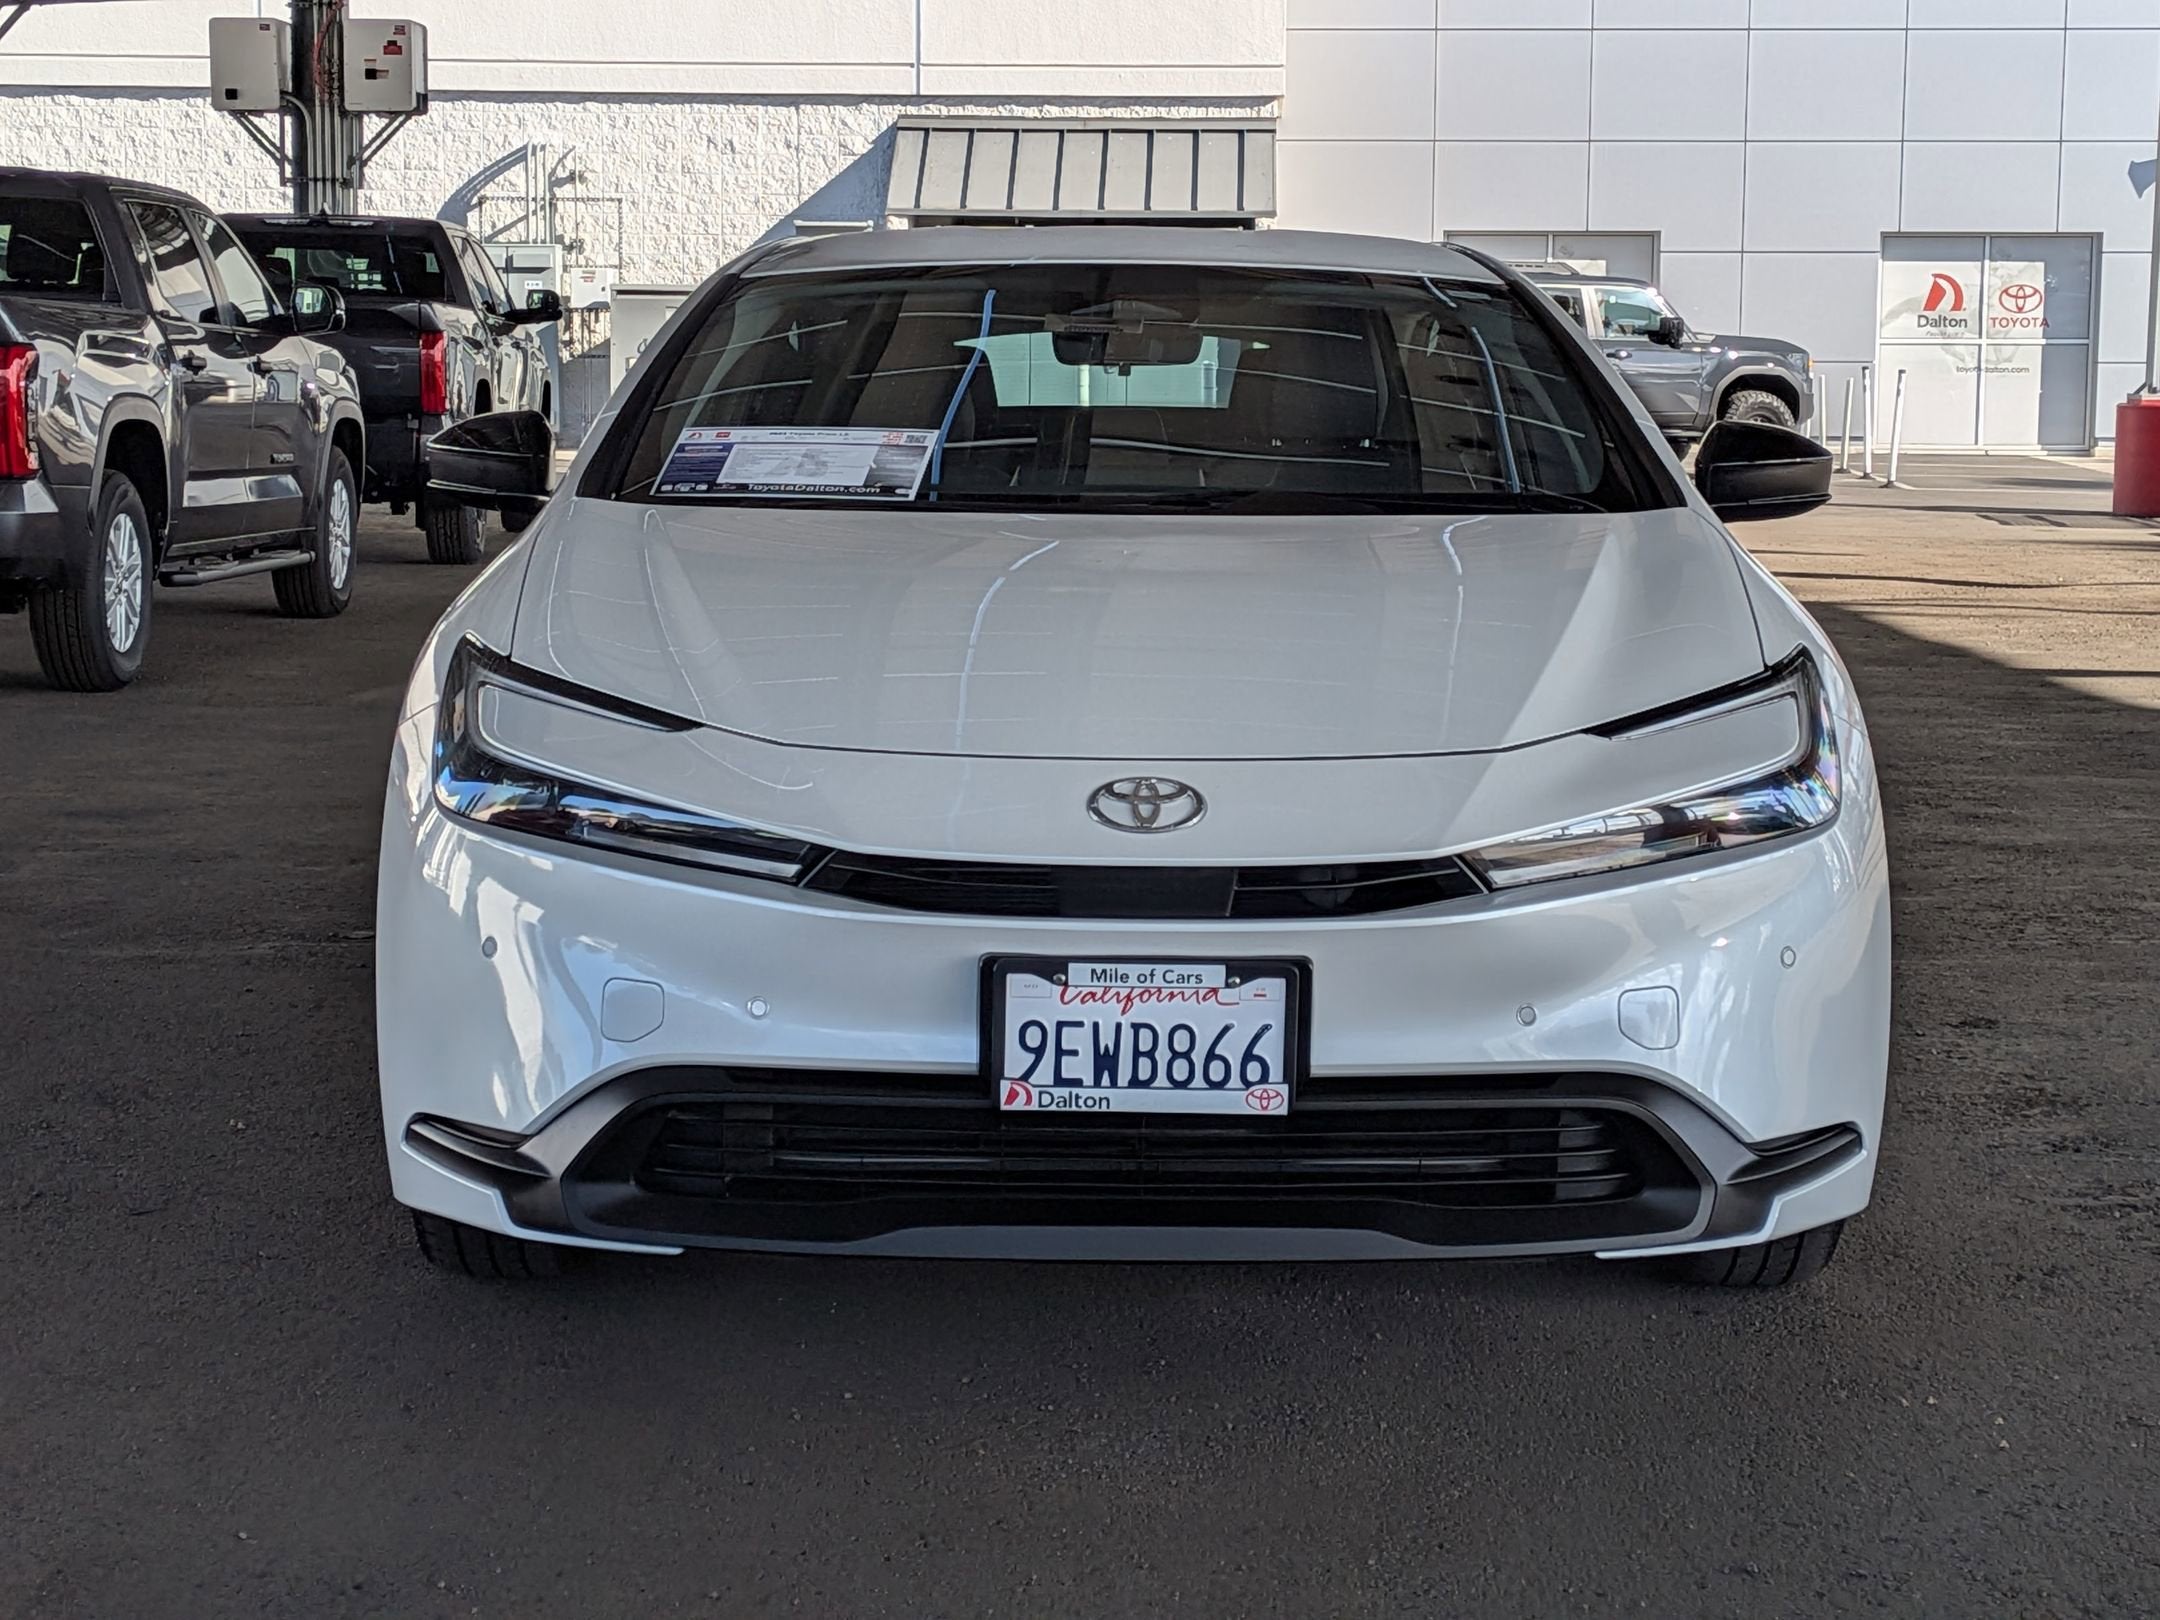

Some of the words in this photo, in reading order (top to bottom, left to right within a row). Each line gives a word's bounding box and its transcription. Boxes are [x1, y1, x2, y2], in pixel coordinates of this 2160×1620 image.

[1917, 314, 1968, 328] Dalton
[1990, 317, 2050, 328] TOYOTA
[1956, 366, 2030, 374] toyotdalton.com
[747, 483, 881, 494] ToyotaDalton.com
[1090, 968, 1130, 984] Mile
[1137, 969, 1157, 984] of
[1162, 969, 1204, 985] Cars
[1059, 985, 1240, 1016] California
[1018, 1019, 1273, 1090] 9EWB866
[1037, 1090, 1111, 1110] Dalton
